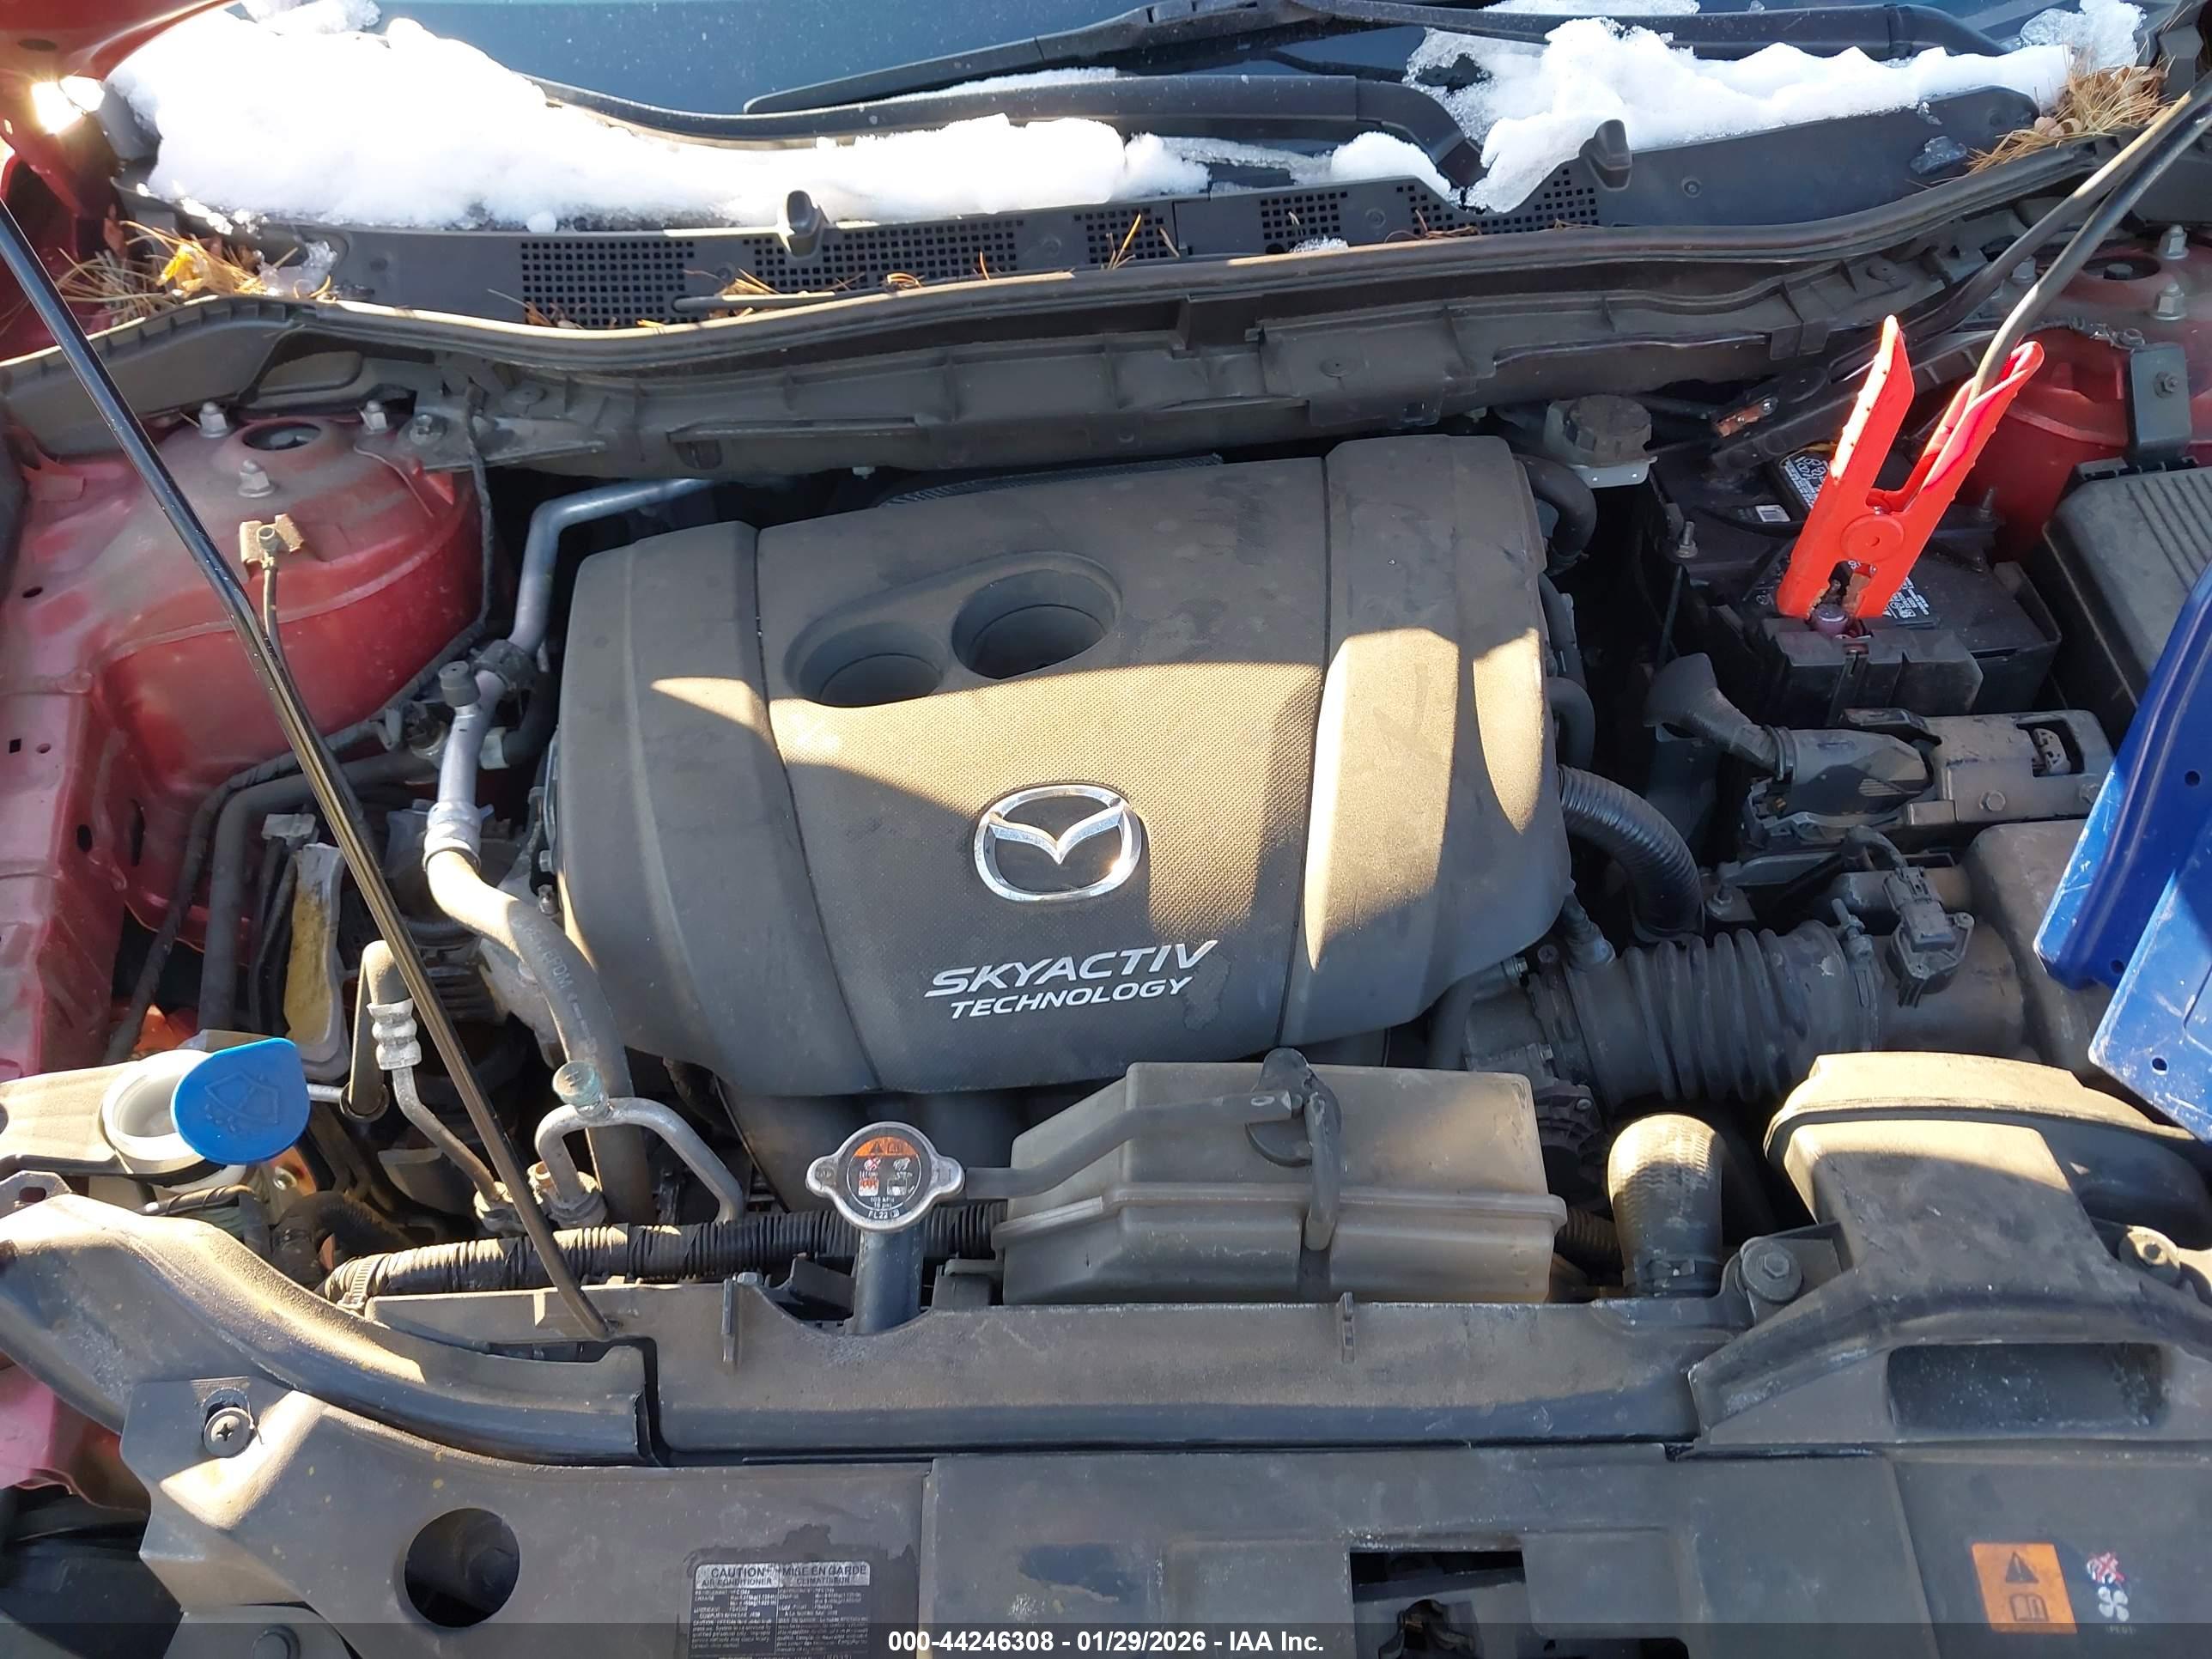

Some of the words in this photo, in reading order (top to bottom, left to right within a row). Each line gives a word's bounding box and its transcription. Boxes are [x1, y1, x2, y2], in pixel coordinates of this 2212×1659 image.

[924, 939, 1218, 998] SKYACTIV
[951, 975, 1193, 1019] TECHNOLOGY
[711, 1567, 765, 1578] CAUTION
[782, 1565, 809, 1576] MISE
[811, 1565, 826, 1576] EN
[828, 1565, 867, 1575] GARDE
